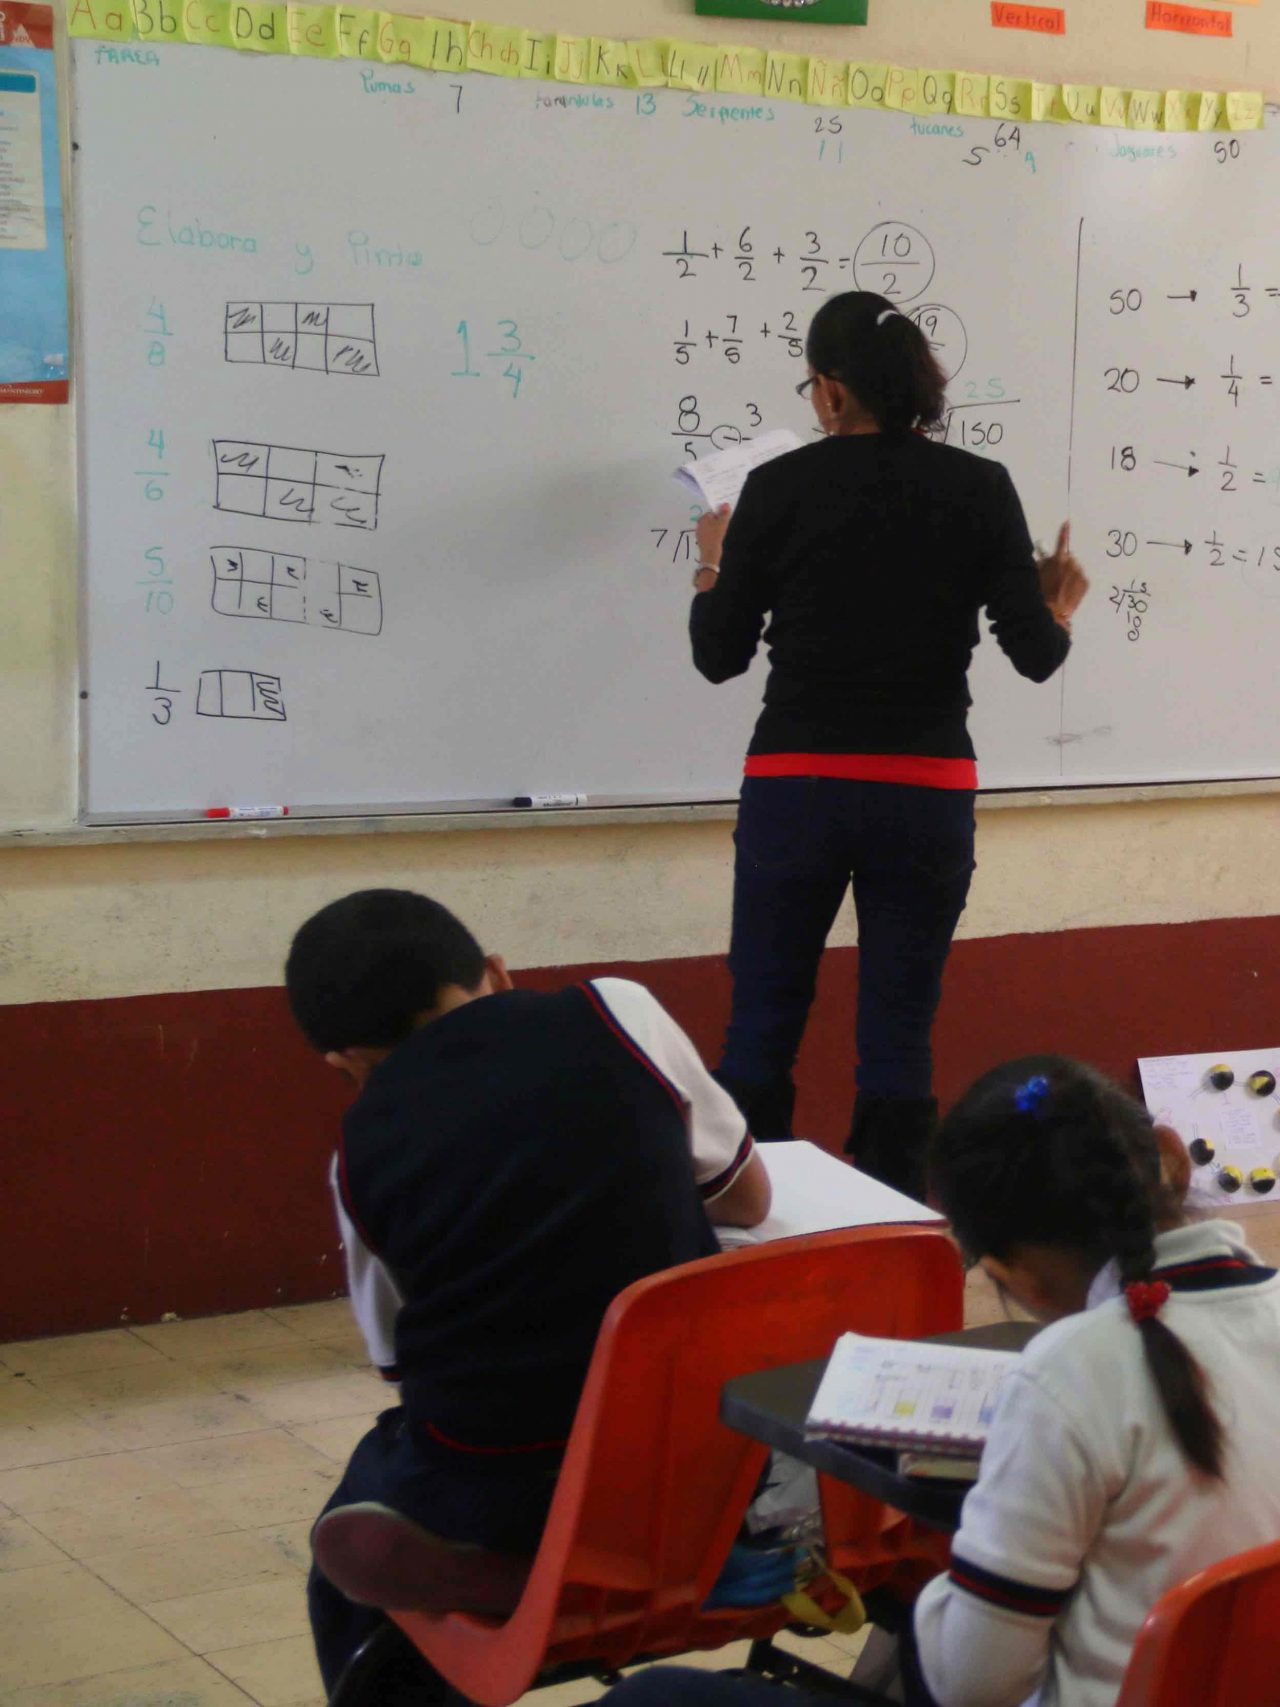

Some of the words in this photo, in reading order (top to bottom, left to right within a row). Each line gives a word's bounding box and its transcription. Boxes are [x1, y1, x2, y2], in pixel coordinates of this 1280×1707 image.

[994, 5, 1061, 30] Vertical
[449, 85, 463, 114] 7
[636, 93, 656, 116] 13
[815, 116, 843, 135] 25
[910, 117, 965, 138] tucanes
[136, 205, 258, 254] Elabora
[294, 242, 315, 275] y
[738, 226, 753, 253] 6
[805, 230, 822, 255] 3
[880, 232, 912, 258] 10
[675, 258, 698, 279] 2
[738, 261, 756, 282] 2
[800, 265, 827, 292] 2
[882, 272, 902, 296] 2
[1109, 288, 1142, 315] 50
[1232, 293, 1251, 318] 3
[498, 319, 522, 353] 3
[726, 315, 739, 334] 7
[782, 311, 798, 332] 2
[674, 345, 691, 366] 5
[501, 362, 523, 398] 4
[1103, 367, 1139, 393] 20
[1227, 379, 1239, 407] 4
[677, 395, 700, 433] 8
[745, 403, 763, 427] 3
[961, 421, 1004, 447] 150
[1110, 445, 1136, 471] 18
[143, 479, 165, 502] 6
[1220, 471, 1237, 491] 2
[1106, 529, 1137, 558] 30
[143, 545, 165, 577] 5
[1209, 549, 1225, 567] 2
[151, 697, 173, 726] 3
